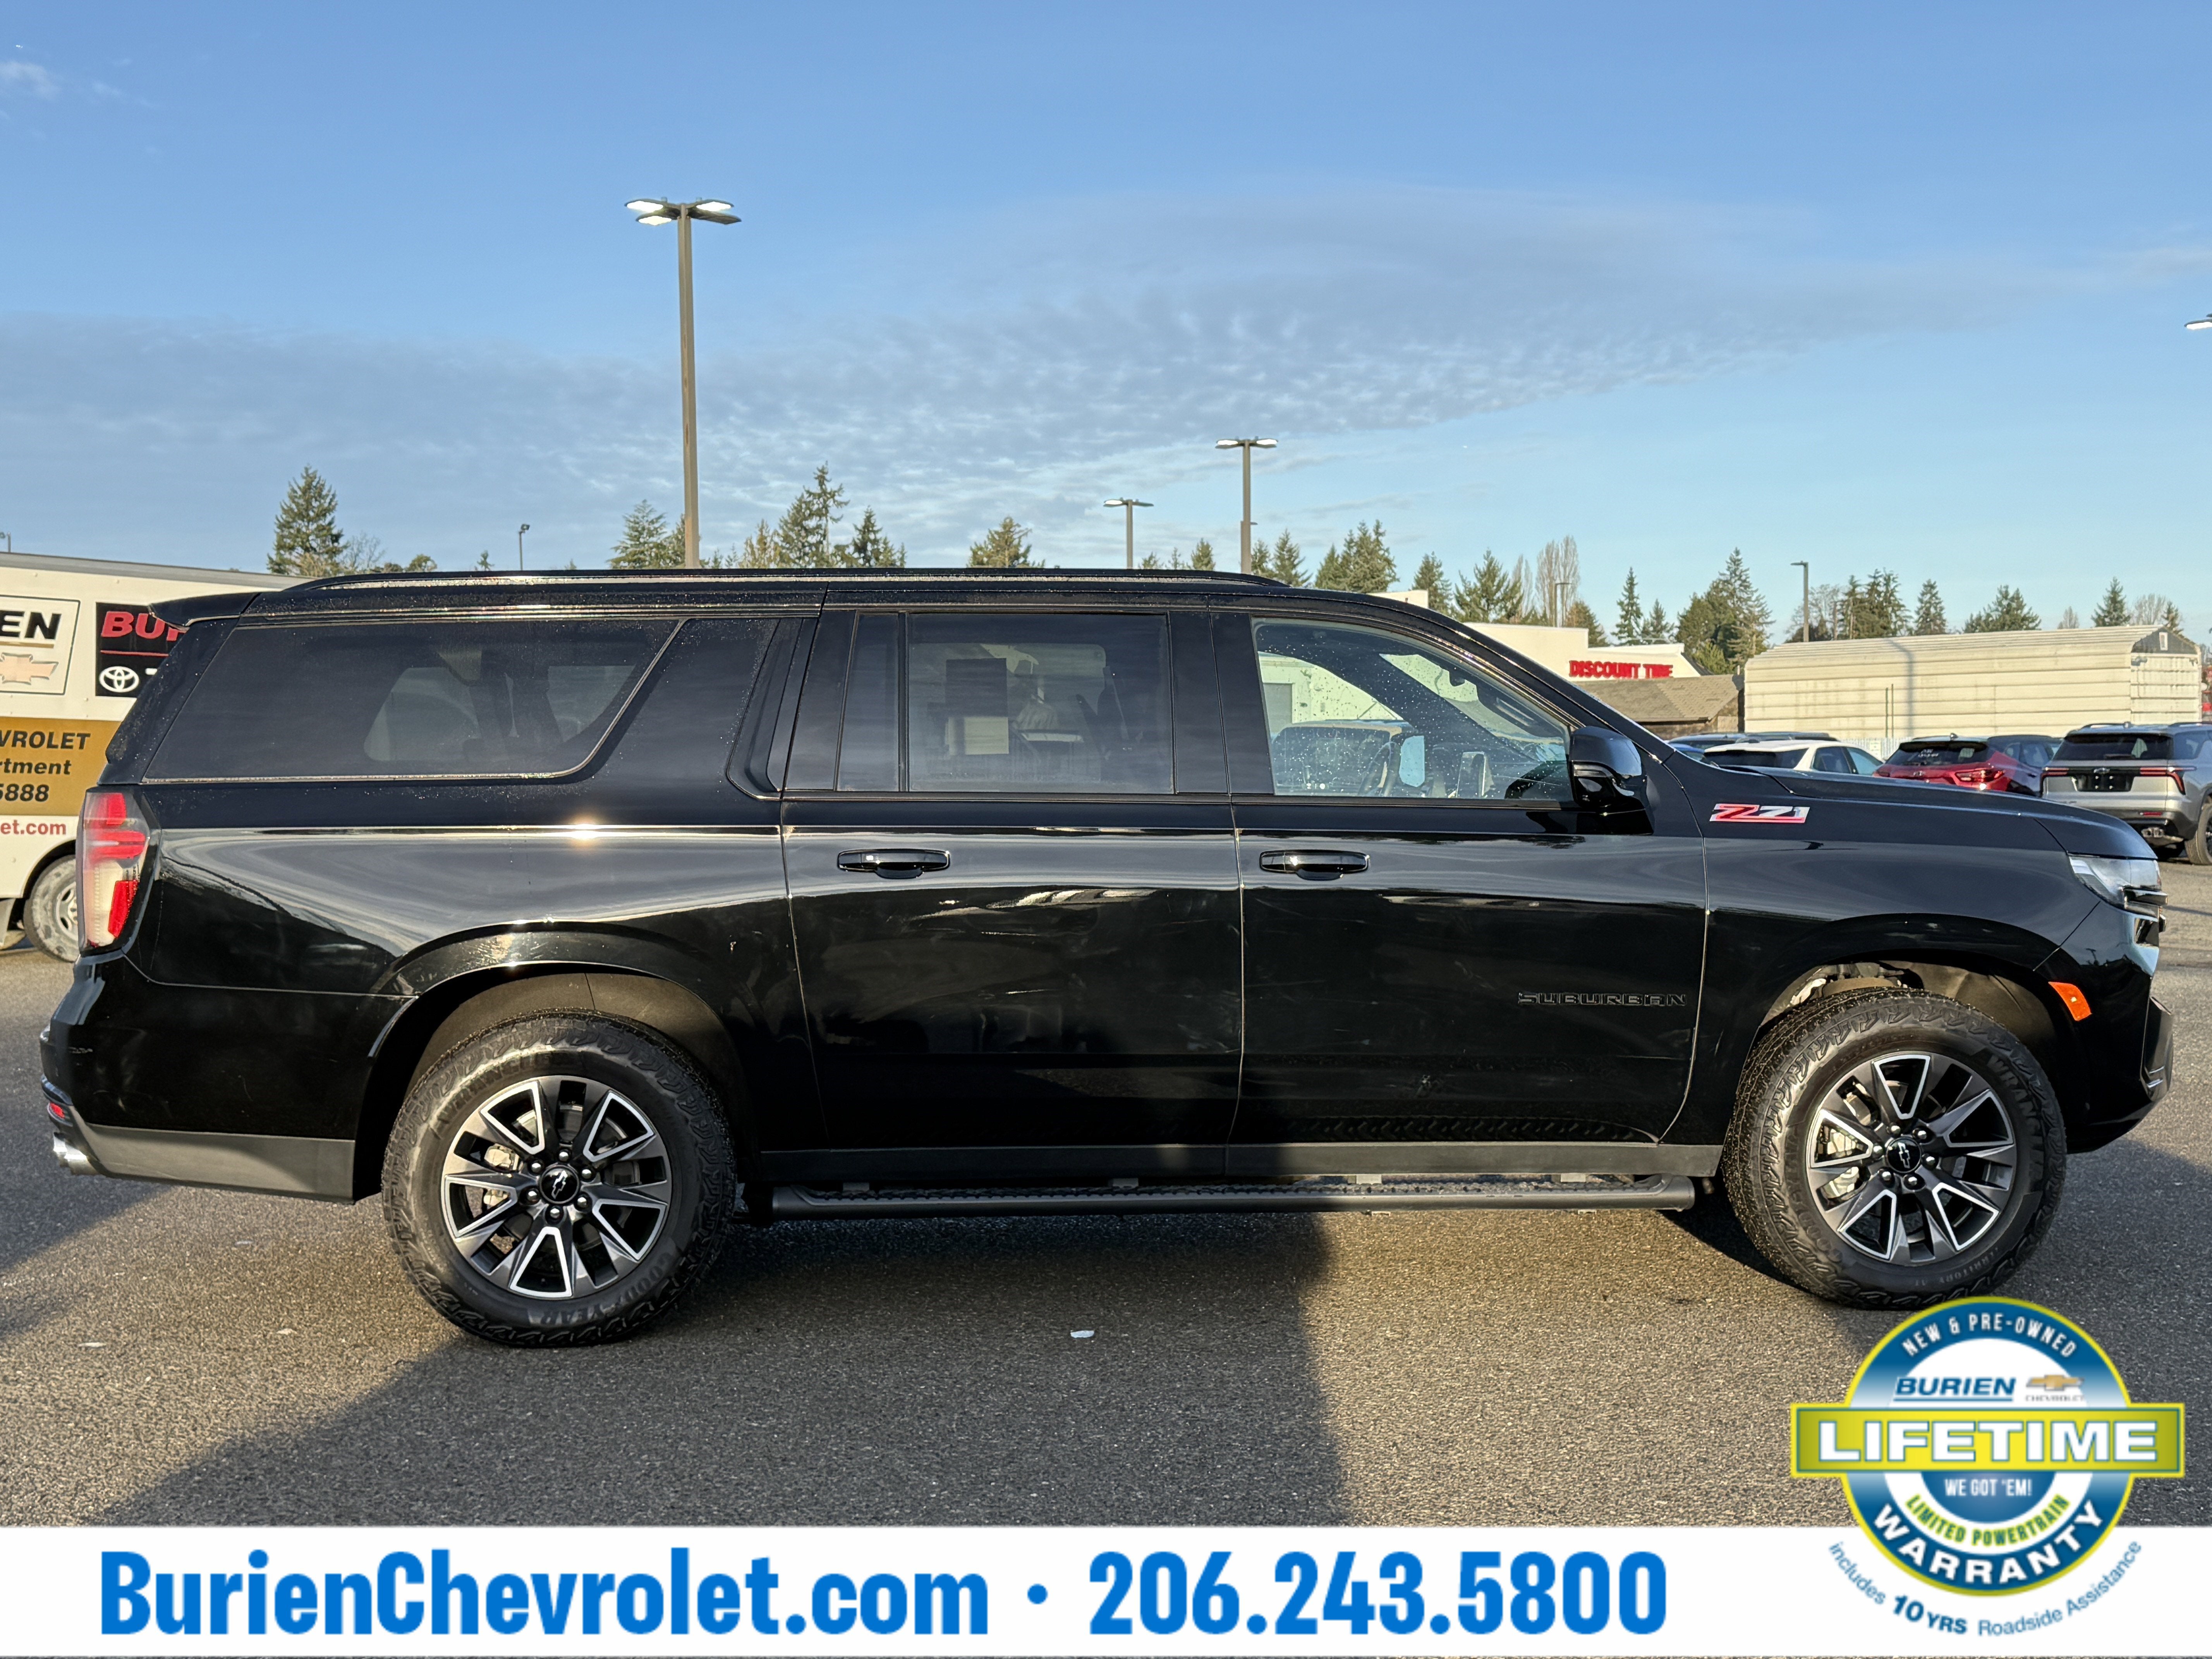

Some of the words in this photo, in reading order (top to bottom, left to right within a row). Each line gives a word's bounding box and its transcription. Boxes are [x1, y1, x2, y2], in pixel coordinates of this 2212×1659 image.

[1569, 660, 1641, 679] DISCOUNT
[1643, 663, 1673, 678] TIRE
[1709, 804, 1810, 823] Z71
[0, 819, 66, 835] et.com
[1518, 992, 1686, 1006] SUBURBAN
